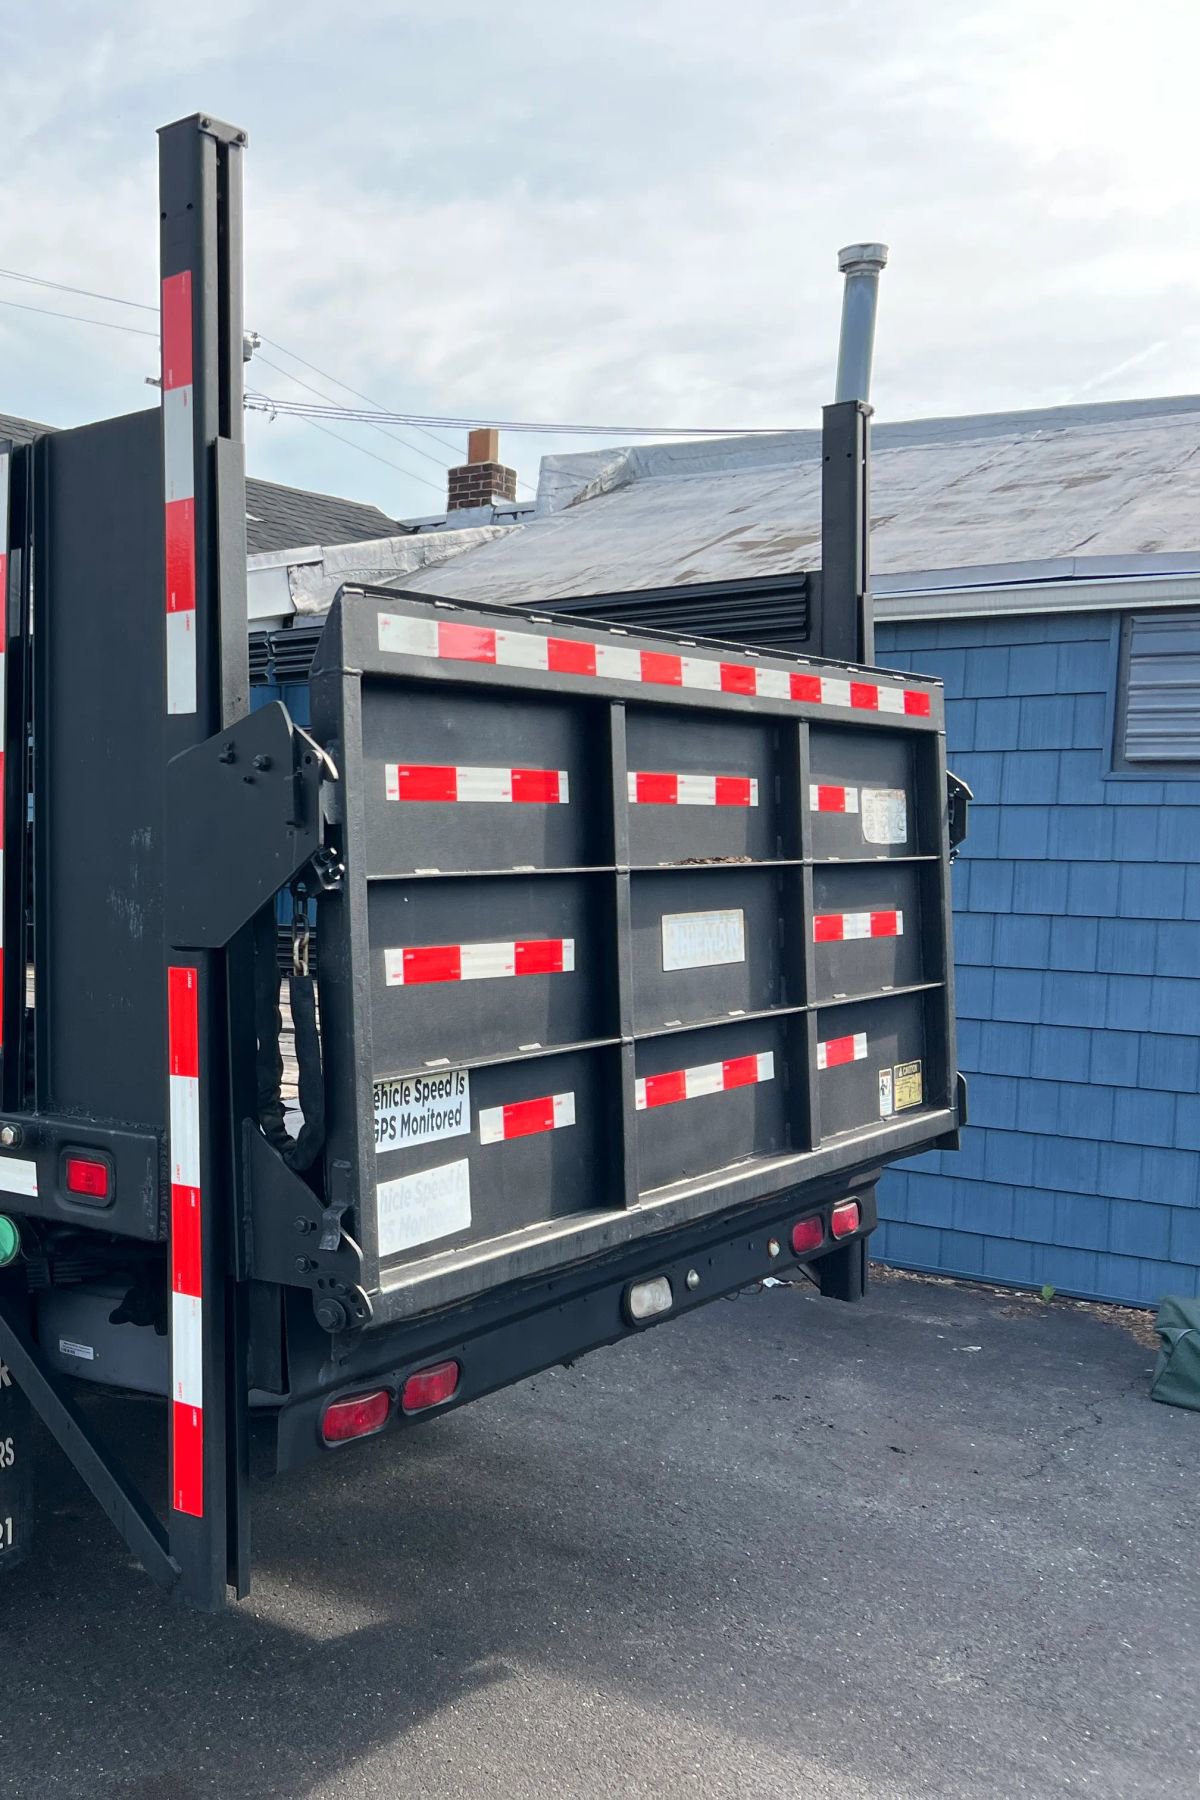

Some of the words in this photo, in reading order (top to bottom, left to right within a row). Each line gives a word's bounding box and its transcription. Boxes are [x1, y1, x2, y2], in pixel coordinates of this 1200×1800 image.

[373, 1081, 411, 1111] ehicle
[414, 1072, 452, 1107] Speed
[455, 1072, 465, 1096] Is
[373, 1115, 397, 1142] GPS
[400, 1100, 463, 1138] Monitored
